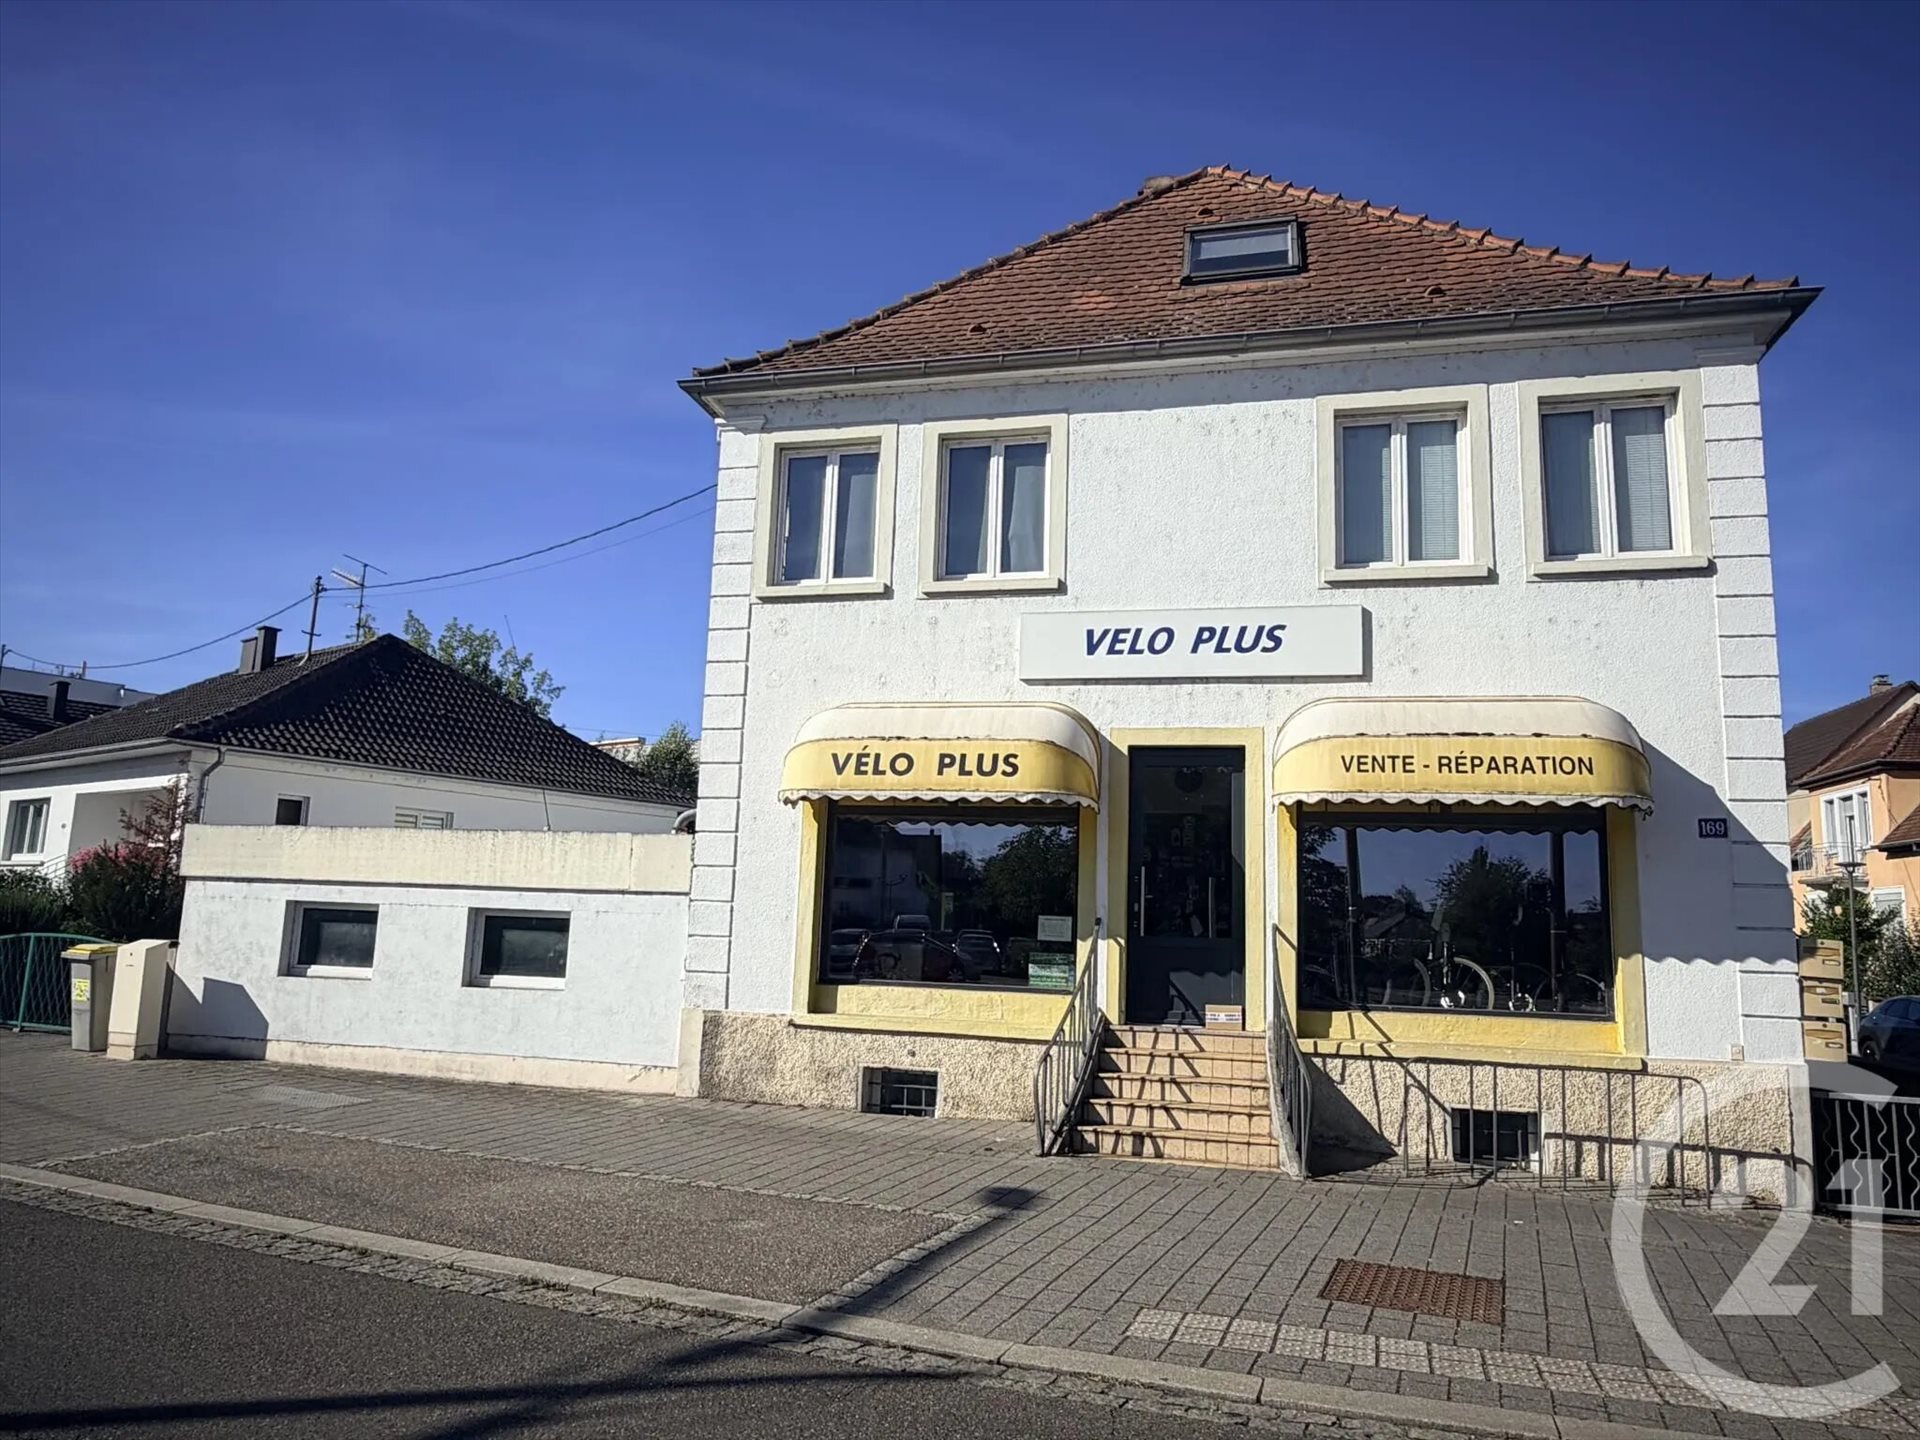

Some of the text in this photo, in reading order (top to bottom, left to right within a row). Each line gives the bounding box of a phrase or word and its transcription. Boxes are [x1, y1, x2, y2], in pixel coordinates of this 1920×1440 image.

[1085, 624, 1287, 656] VELO PLUS
[831, 745, 1019, 778] VÉLO PLUS
[1341, 755, 1416, 774] VENTE
[1437, 750, 1594, 776] RÉPARATION
[1700, 820, 1725, 836] 169
